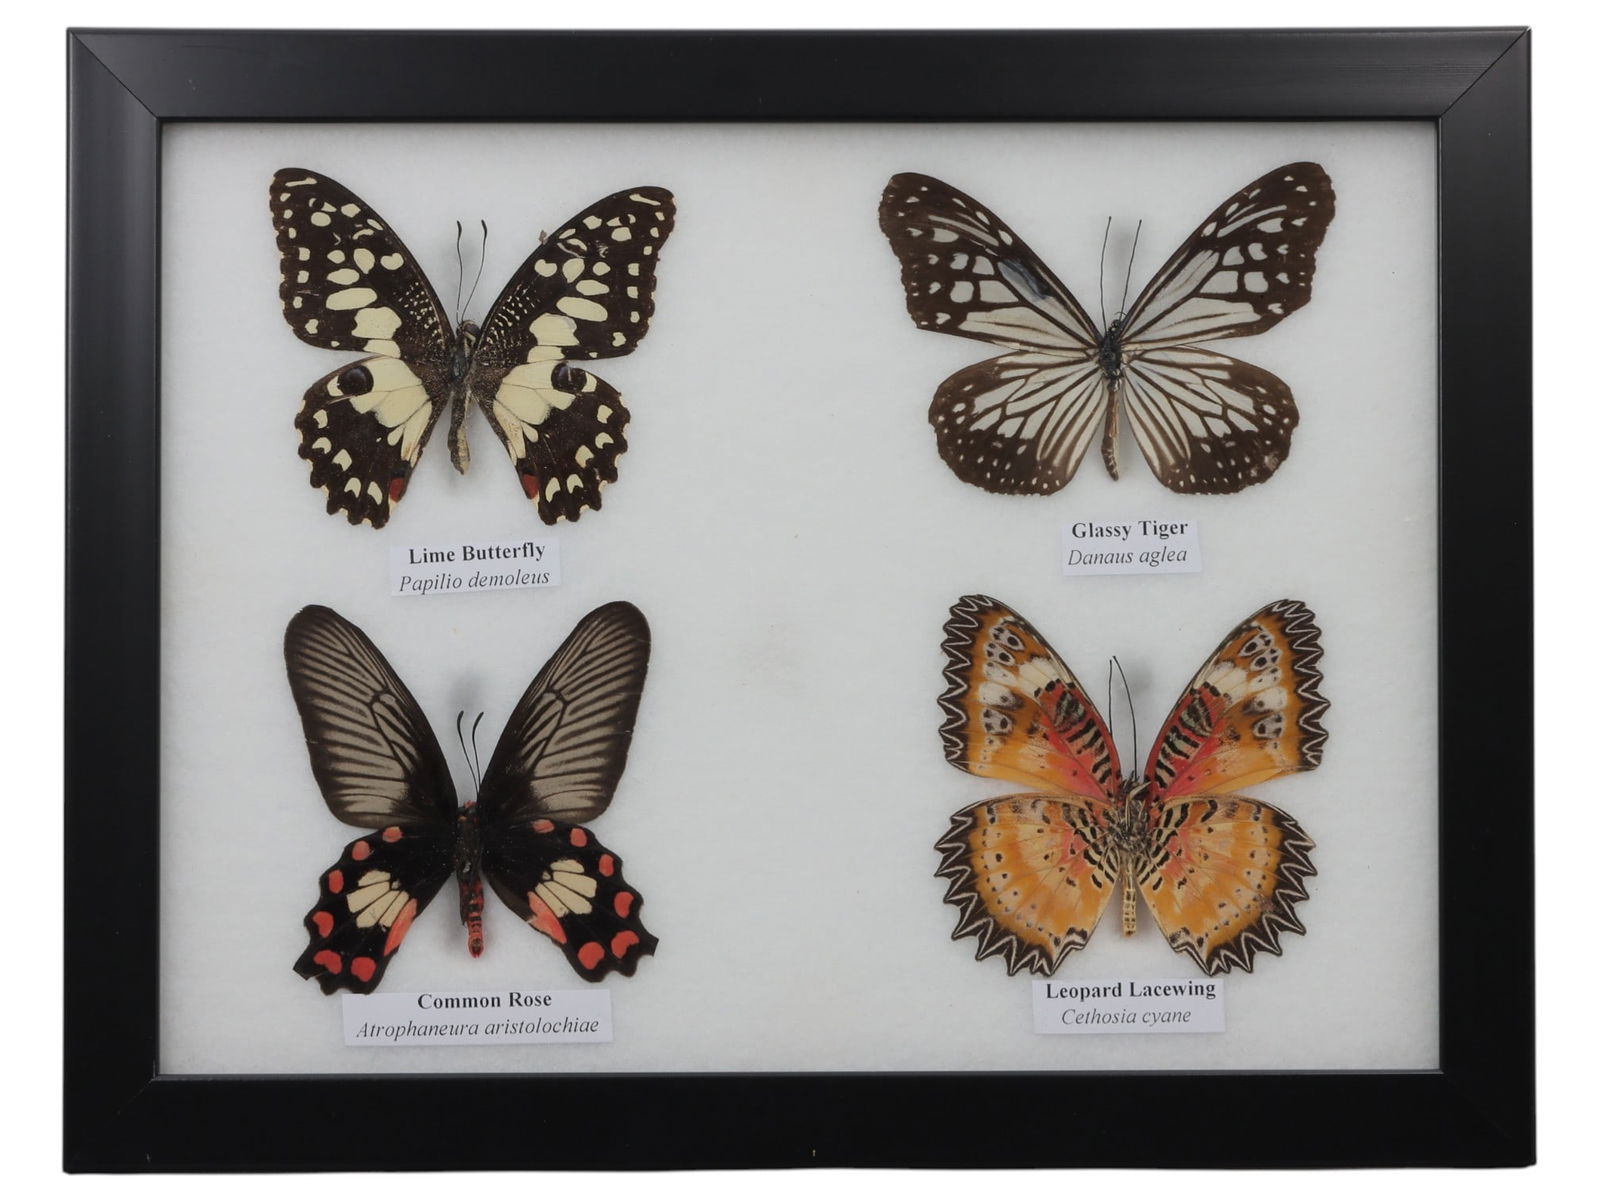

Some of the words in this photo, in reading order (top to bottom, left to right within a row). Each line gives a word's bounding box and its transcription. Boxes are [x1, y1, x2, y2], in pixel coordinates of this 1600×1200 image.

[1071, 522, 1132, 541] Glassy
[1137, 520, 1189, 540] Tiger
[409, 547, 456, 564] Lime
[462, 542, 546, 562] Butterfly
[1068, 549, 1134, 566] Danaus
[1139, 545, 1188, 567] aglea
[399, 573, 462, 595] Papilio
[468, 568, 551, 588] demoleus
[417, 993, 501, 1009] Common
[508, 991, 553, 1008] Rose
[1046, 982, 1122, 1001] Leopard
[1129, 980, 1217, 1000] Lacewing
[1061, 1008, 1137, 1025] Cethosia
[1141, 1010, 1192, 1027] cyane
[356, 1020, 480, 1041] Atrophaneura
[484, 1017, 600, 1035] aristolochiae
